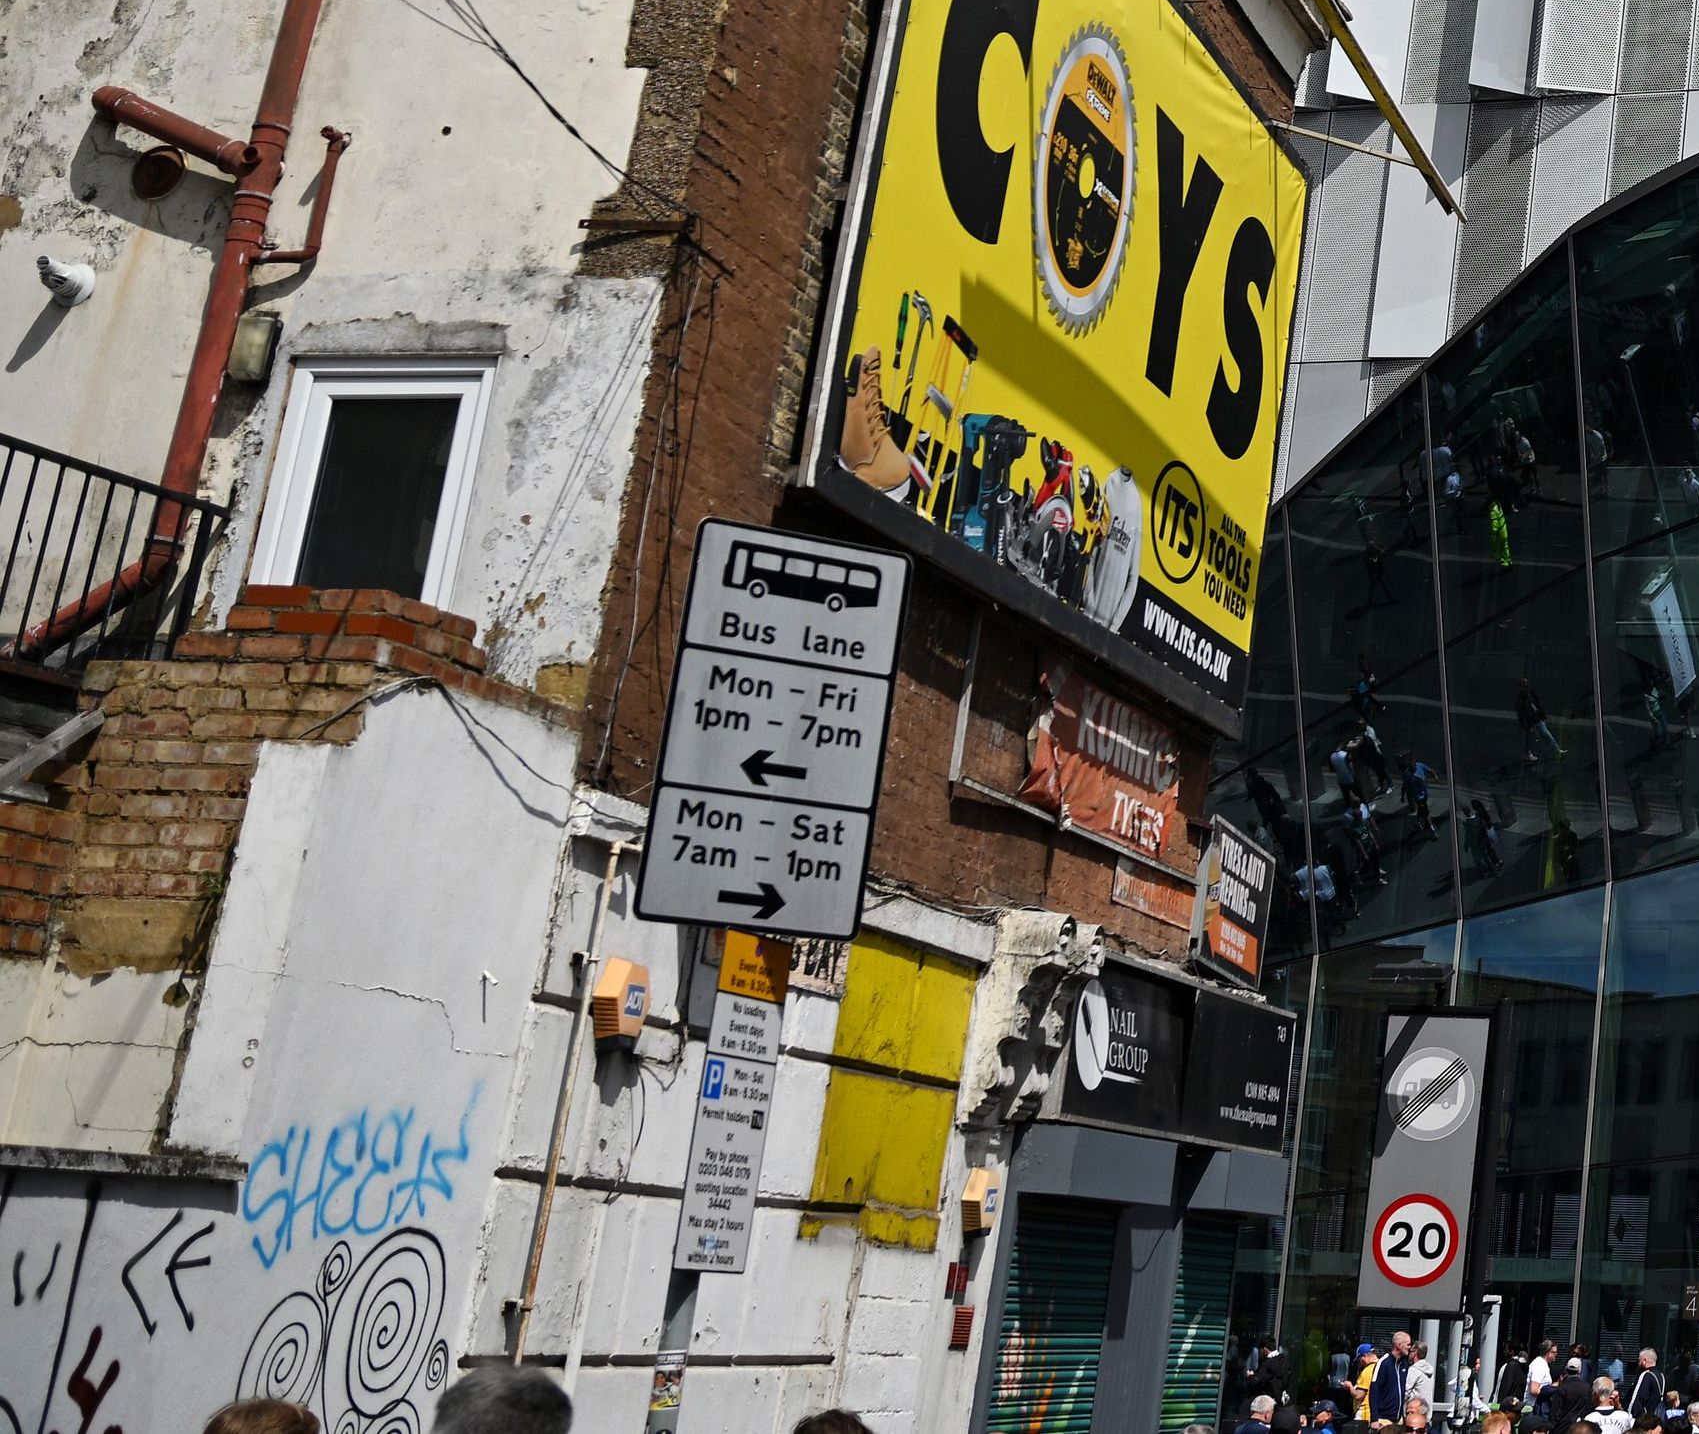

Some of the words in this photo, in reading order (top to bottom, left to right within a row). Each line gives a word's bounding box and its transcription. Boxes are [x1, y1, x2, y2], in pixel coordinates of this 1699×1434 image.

[1159, 484, 1198, 559] ITS
[1221, 514, 1234, 538] ALL
[1234, 523, 1246, 545] THE
[1208, 529, 1252, 593] TOOLS
[1203, 569, 1222, 604] YOU
[1224, 586, 1246, 621] NEED
[720, 612, 777, 645] Bus
[803, 625, 866, 661] lane
[1143, 598, 1231, 683] WWW.ITS.CO.UK
[709, 665, 773, 699] Mon
[819, 683, 858, 713] Fri
[694, 699, 750, 733] 1pm
[800, 715, 862, 749] 7pm
[1077, 685, 1180, 793] KUMHO
[676, 799, 743, 832] Mon
[791, 814, 846, 846] Sat
[1111, 790, 1164, 852] TYRES
[671, 835, 737, 868] 7am
[786, 850, 842, 882] 1pm
[1220, 832, 1243, 876] TYRES
[1247, 853, 1266, 892] AUTO
[1219, 872, 1249, 918] REPAIRS
[729, 1020, 748, 1034] Event
[749, 1022, 764, 1038] days
[733, 1001, 742, 1013] No
[744, 1003, 767, 1020] loading
[1110, 1007, 1138, 1038] NAIL
[1109, 1041, 1149, 1073] GROUP
[707, 1064, 722, 1095] P
[702, 1106, 724, 1121] Permit
[726, 1109, 750, 1124] holders
[705, 1148, 717, 1162] Pay
[718, 1150, 727, 1163] by
[728, 1151, 749, 1164] phone
[726, 1132, 734, 1142] or
[694, 1182, 720, 1196] quoting
[722, 1184, 748, 1196] location
[688, 1216, 703, 1227] Max
[704, 1218, 718, 1231] stay
[725, 1220, 744, 1231] hours
[1387, 1221, 1446, 1260] 20
[688, 1252, 707, 1264] within
[715, 1254, 734, 1265] hours
[1685, 1297, 1698, 1317] 4
